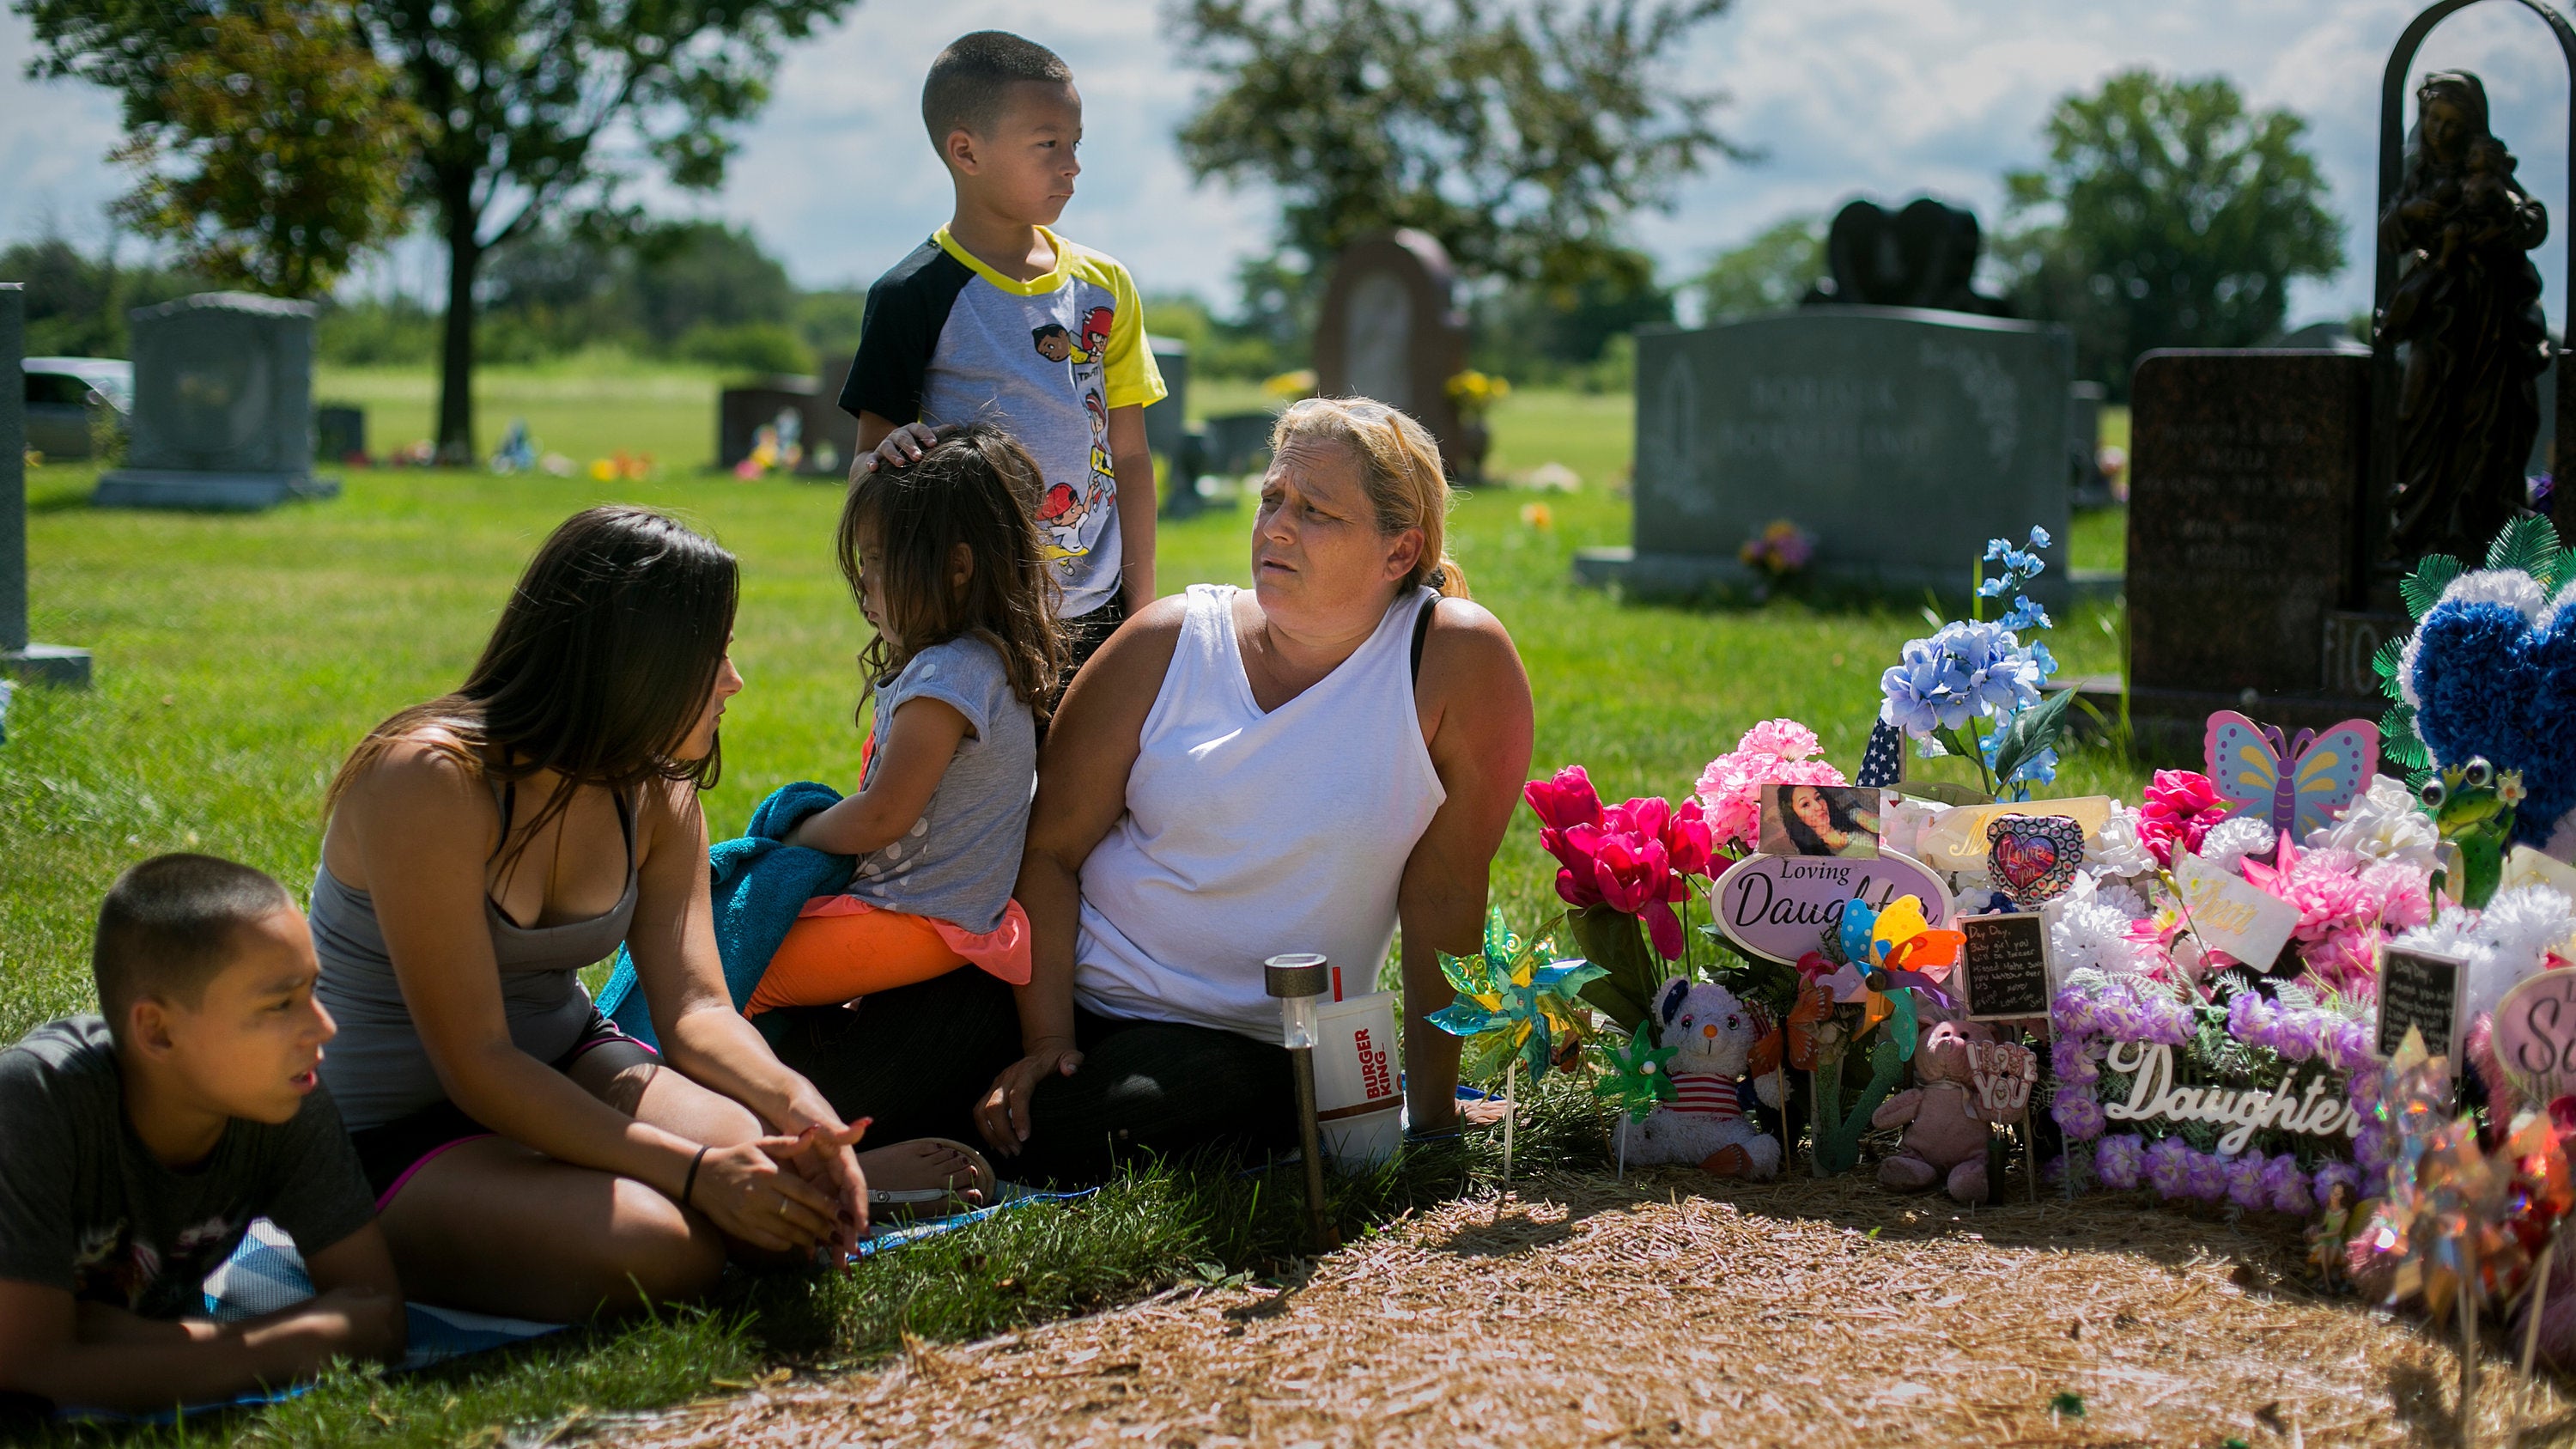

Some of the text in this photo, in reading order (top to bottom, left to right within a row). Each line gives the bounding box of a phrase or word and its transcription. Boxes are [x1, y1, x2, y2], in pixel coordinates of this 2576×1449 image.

[1780, 860, 1852, 886] Loving
[1735, 871, 1940, 940] Daughtr
[2190, 879, 2259, 935] Dear
[1968, 926, 1985, 941] Day
[1971, 942, 1990, 953] Baby
[1994, 939, 2009, 953] girl
[1354, 1028, 1381, 1100] BURGER
[1374, 1050, 1393, 1098] KING
[1965, 1039, 2038, 1082] I LOVE
[1971, 1071, 2033, 1111] YOU
[2104, 1042, 2364, 1155] Daughter
